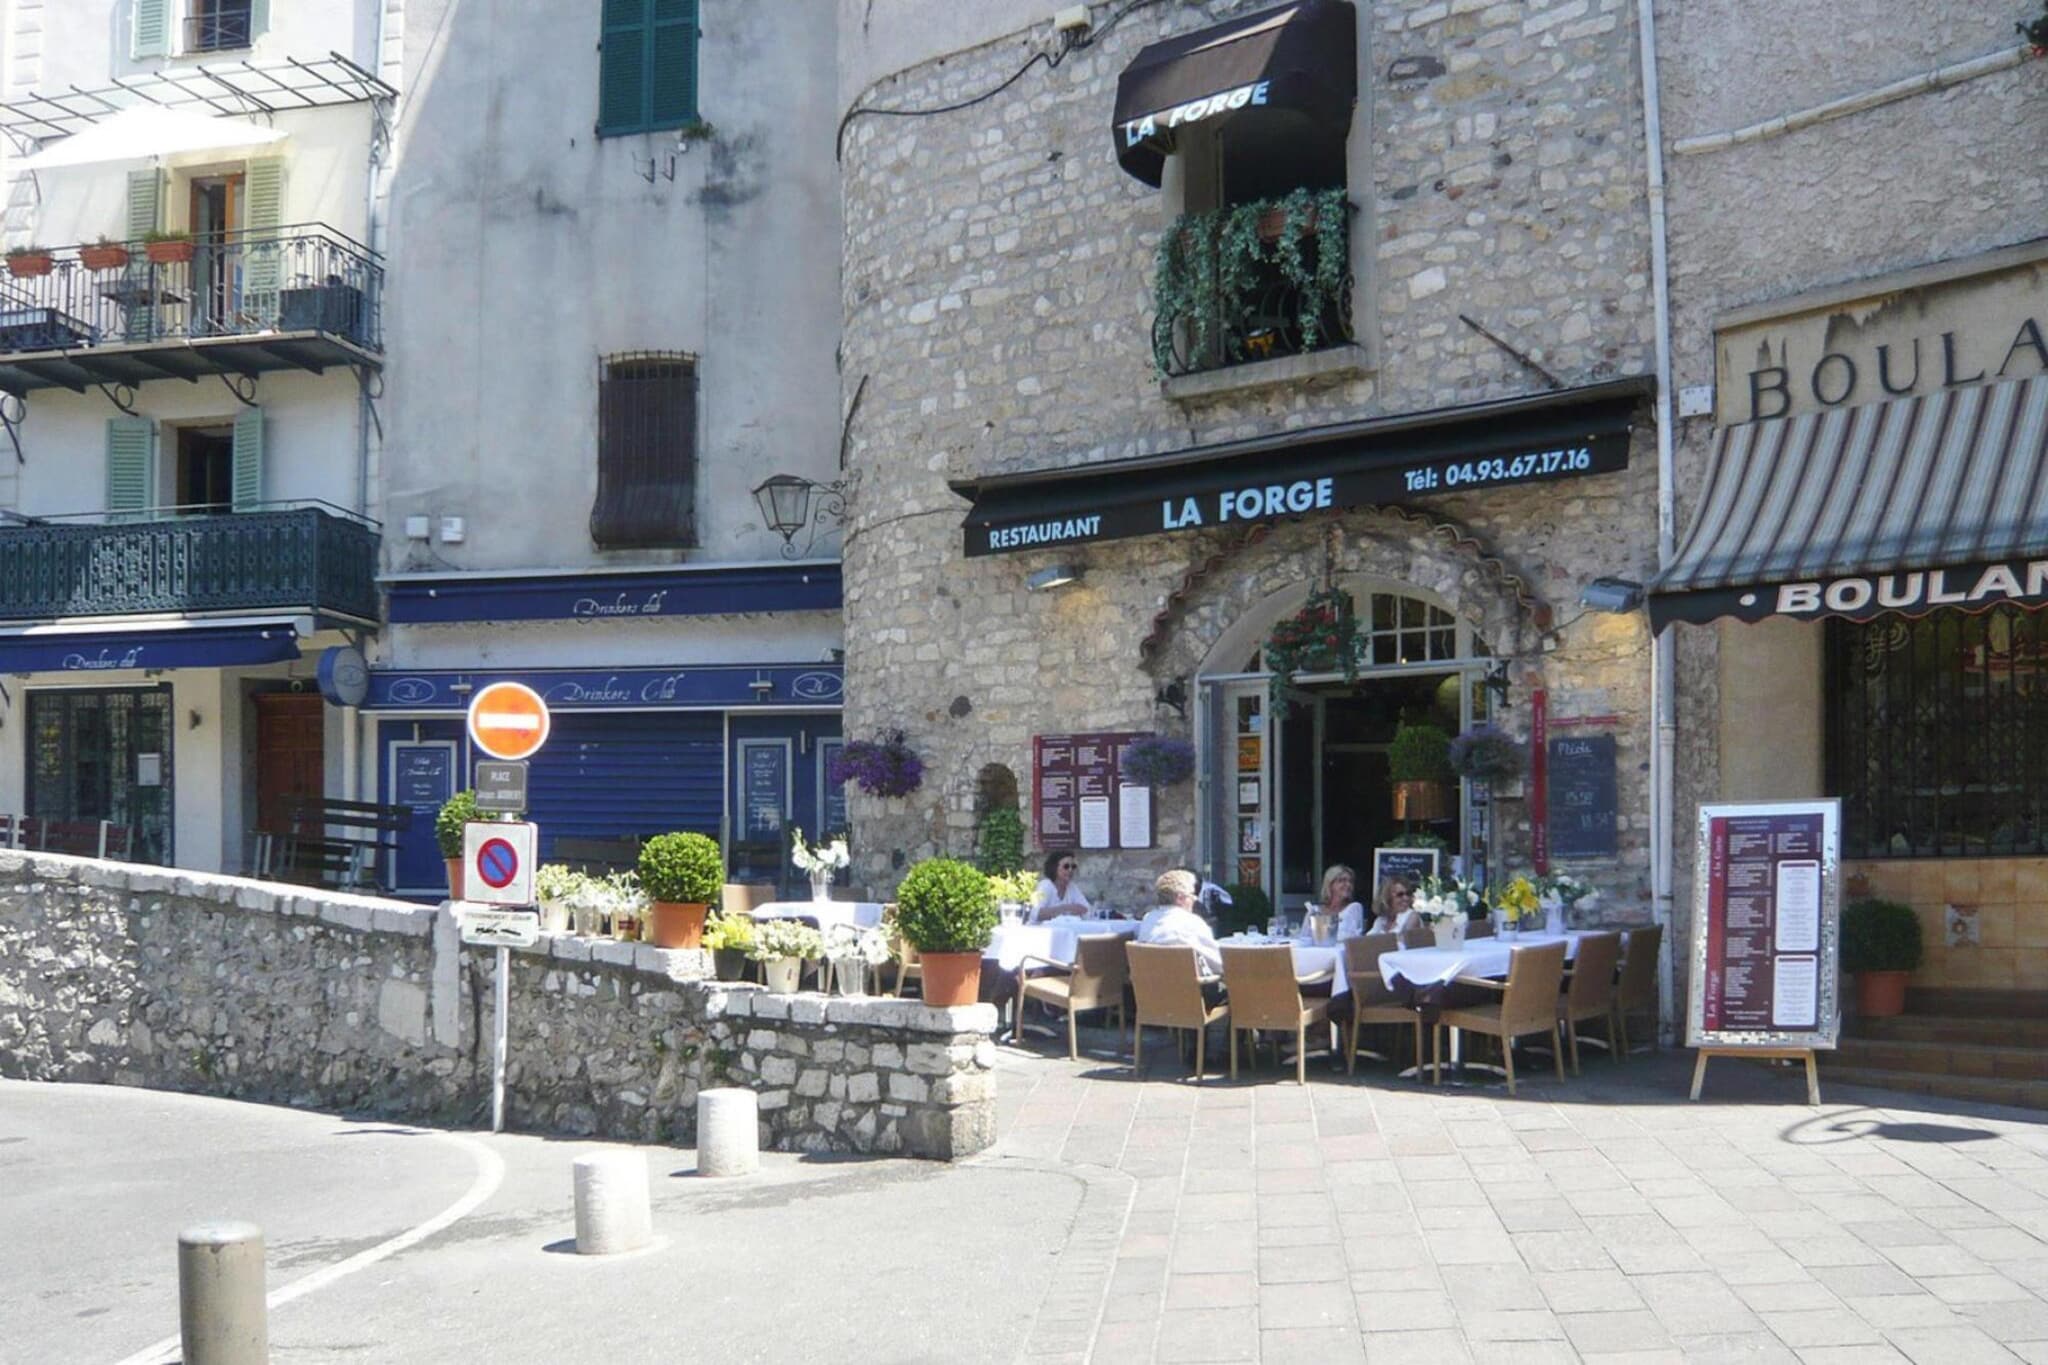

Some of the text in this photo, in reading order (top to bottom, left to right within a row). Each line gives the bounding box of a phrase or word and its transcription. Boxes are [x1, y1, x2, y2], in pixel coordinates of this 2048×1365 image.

[1125, 80, 1270, 147] LA FORGE
[1748, 317, 2048, 421] BOULA
[1405, 448, 1590, 491] Tél: 04.93.67.17.16
[1163, 477, 1333, 529] LA FORGE
[989, 515, 1101, 549] RESTAURANT
